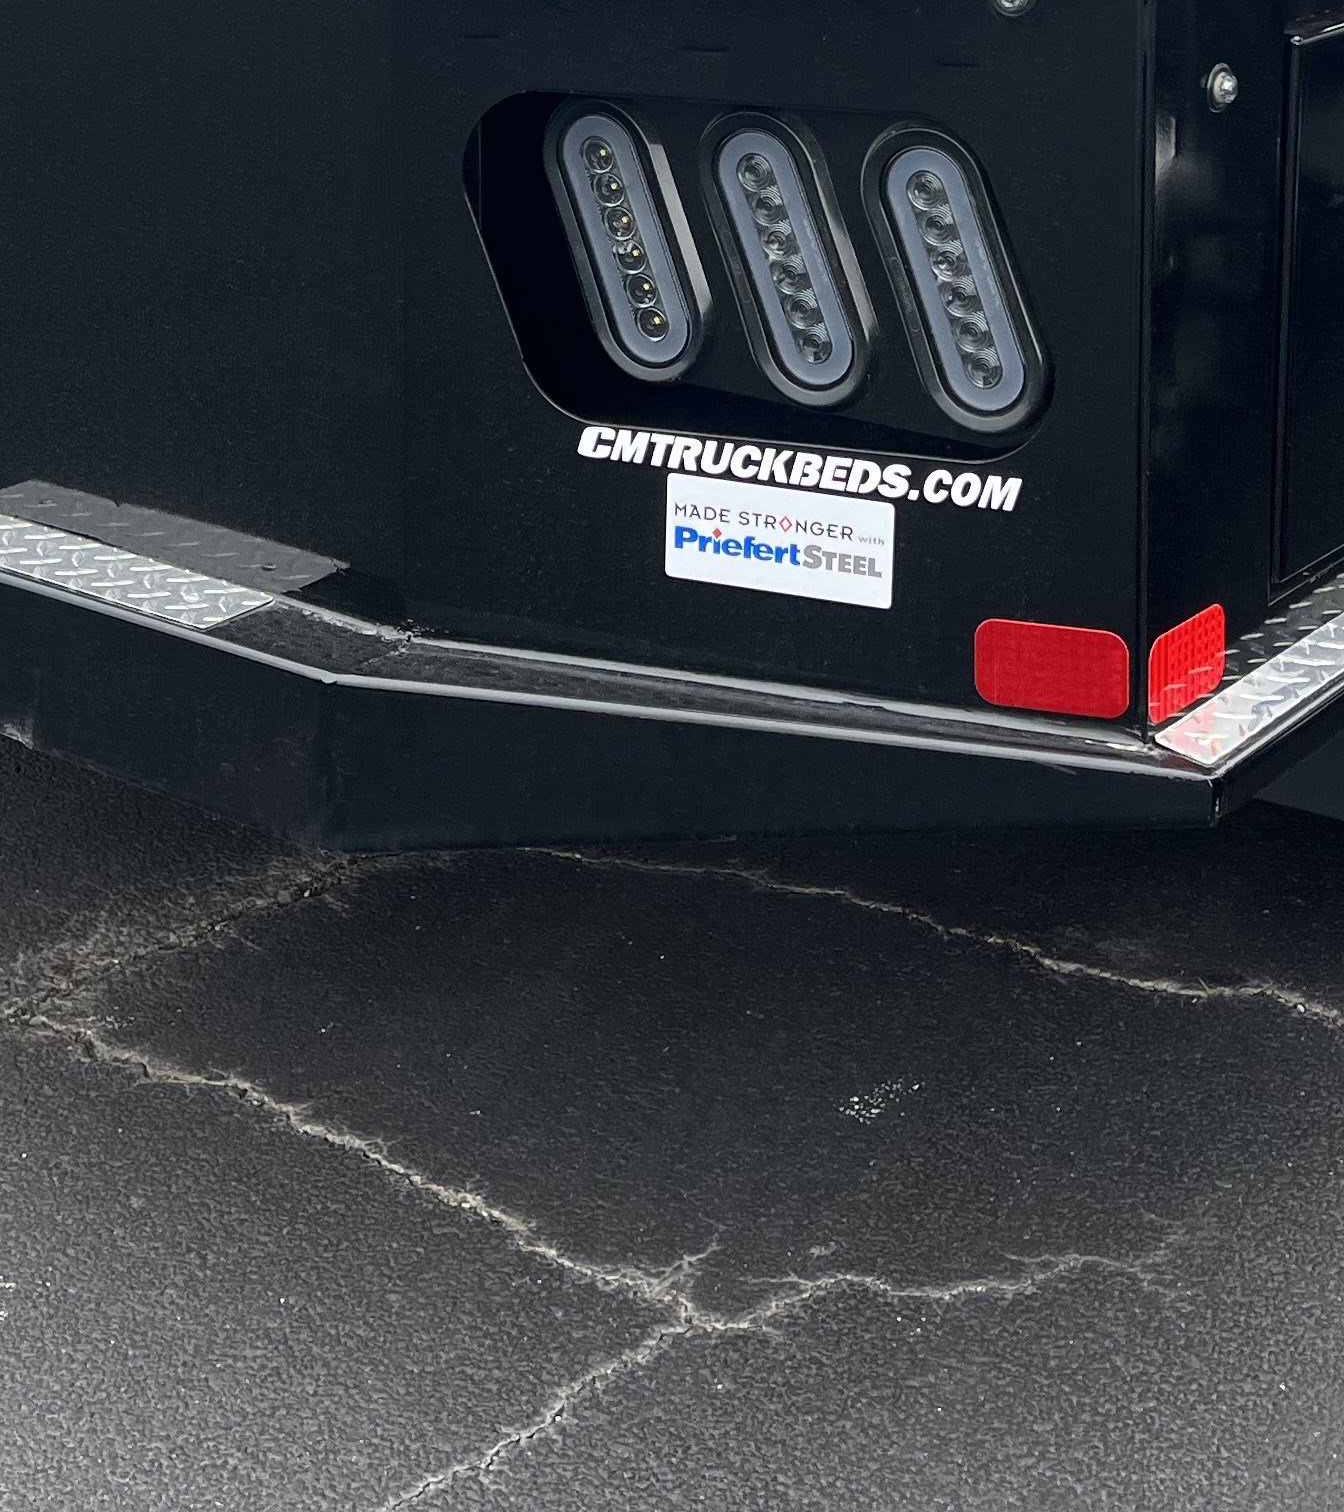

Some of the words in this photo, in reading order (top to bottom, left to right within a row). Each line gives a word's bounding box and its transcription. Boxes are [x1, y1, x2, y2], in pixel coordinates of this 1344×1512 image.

[576, 425, 1023, 512] CMTRUCKBEDS.COM
[674, 502, 731, 524] MADE
[739, 511, 854, 541] STRONGER
[858, 534, 885, 547] with
